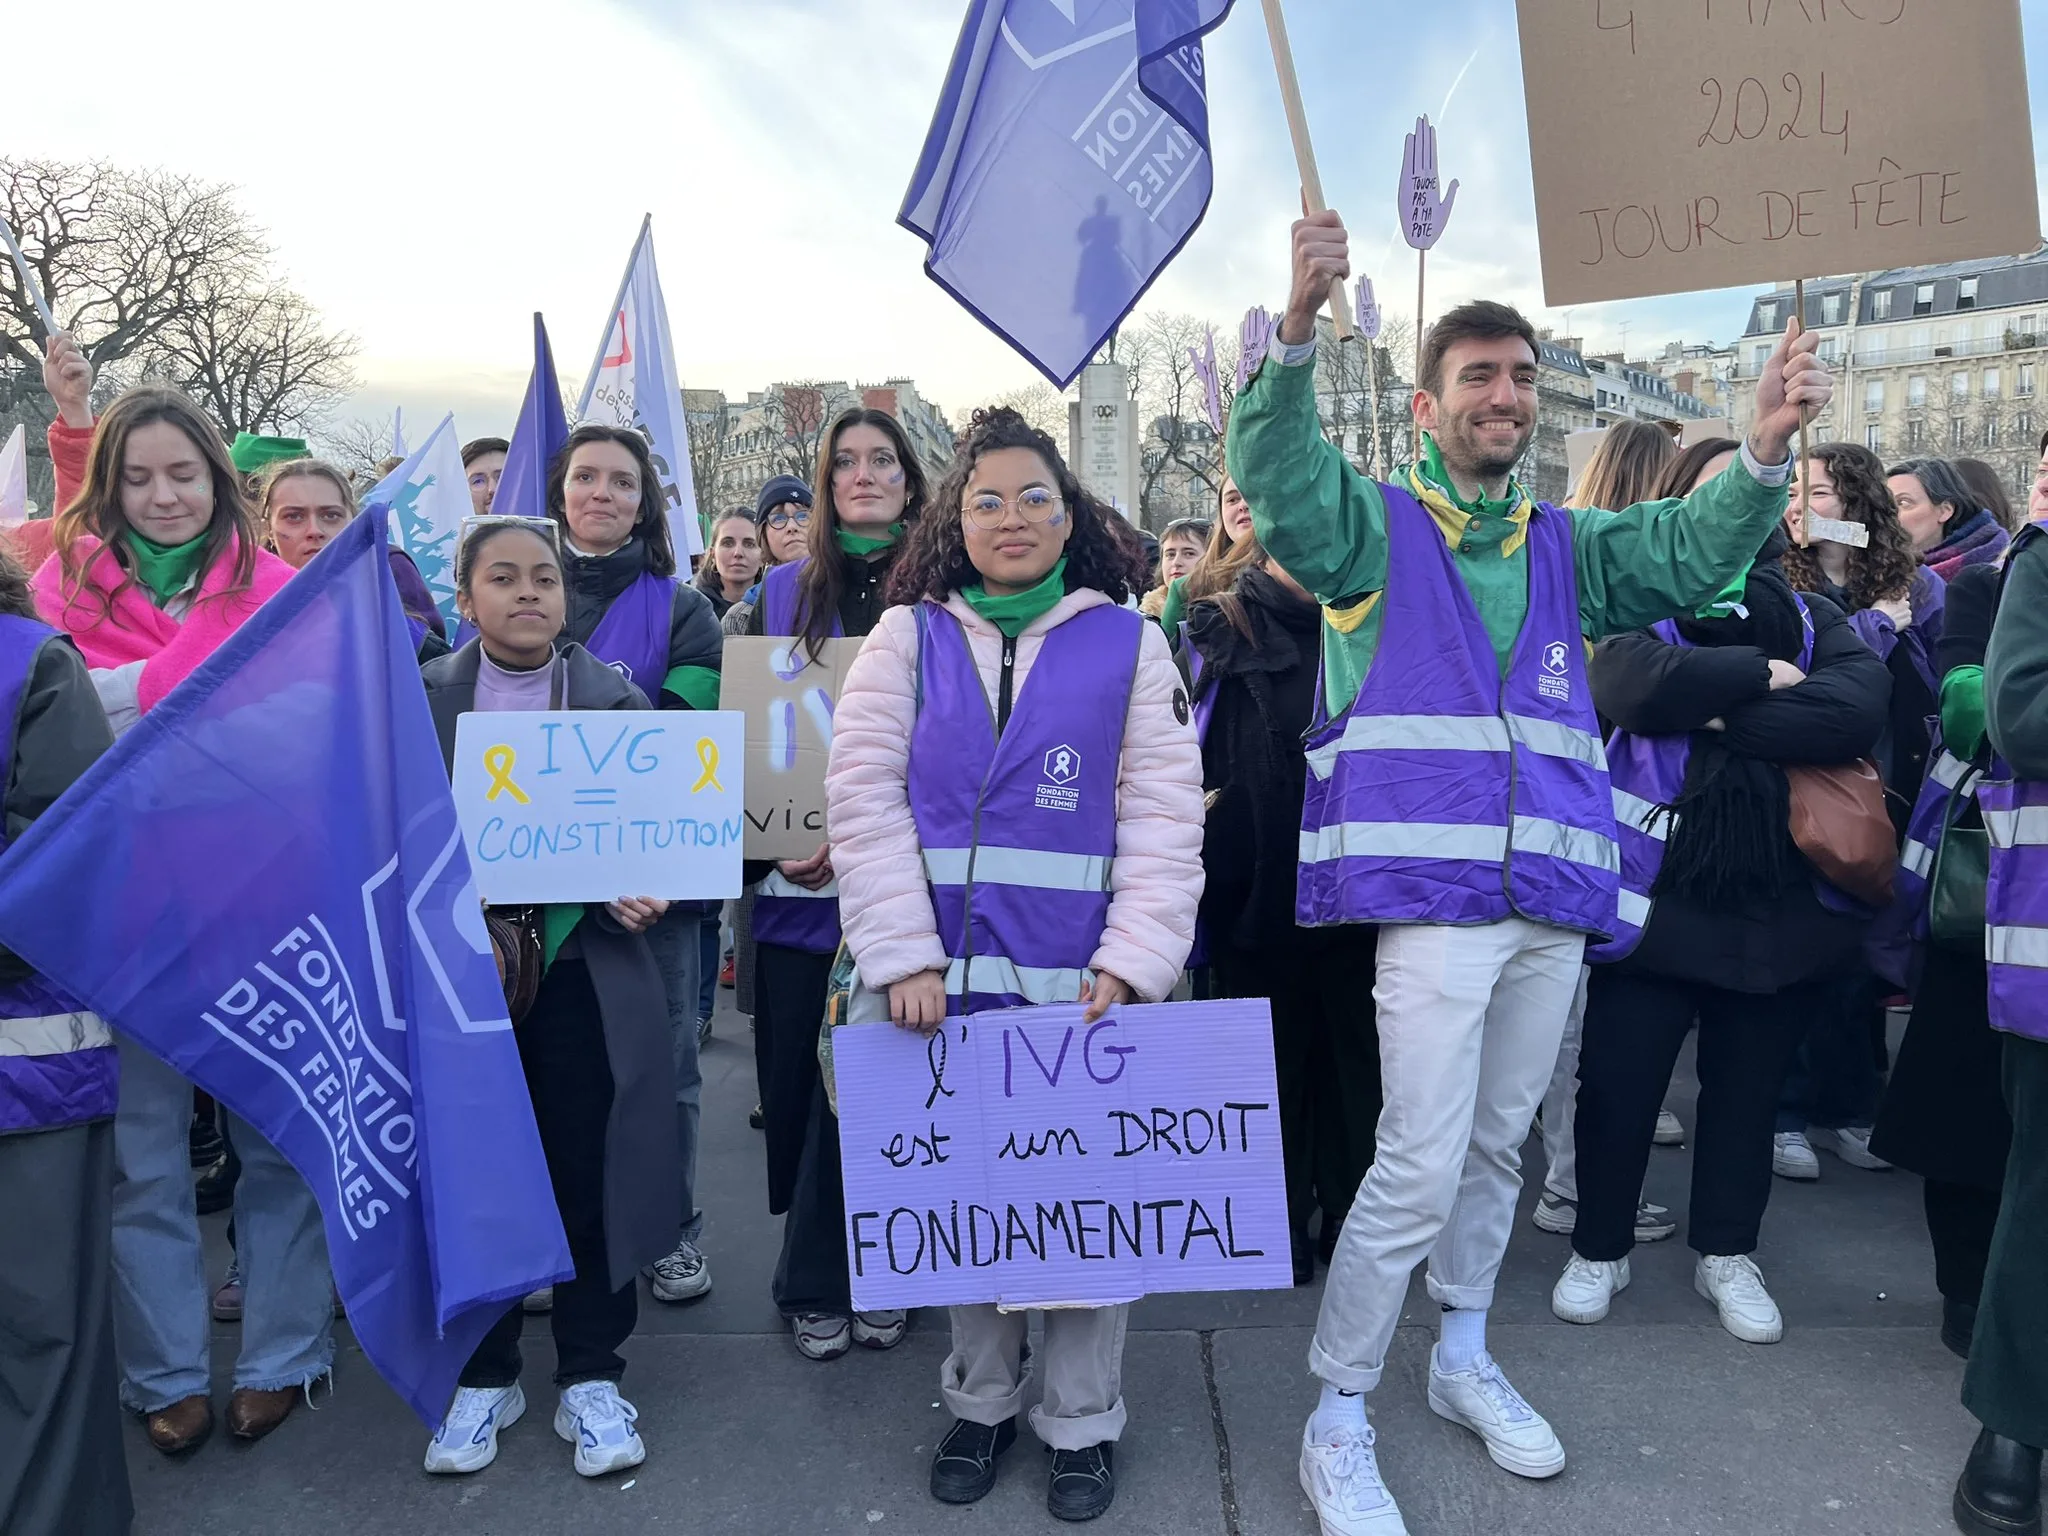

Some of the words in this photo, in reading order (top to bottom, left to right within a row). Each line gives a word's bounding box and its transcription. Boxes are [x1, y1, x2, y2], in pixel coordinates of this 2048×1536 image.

[1698, 72, 1848, 156] 2024
[1412, 176, 1437, 190] TOUCHE
[1412, 191, 1427, 206] PAS
[1579, 196, 1745, 265] JOUR
[1757, 189, 1827, 241] DE
[1849, 157, 1968, 229] FÊTE
[1091, 405, 1118, 418] FOCH
[538, 723, 665, 775] IVG
[1037, 787, 1079, 798] FONDATION
[1051, 799, 1077, 808] FEMMES
[1003, 1019, 1137, 1098] IVG
[214, 977, 307, 1051] DES
[300, 1051, 391, 1230] FEMMES
[880, 1122, 951, 1168] est
[998, 1126, 1088, 1160] un
[1107, 1102, 1269, 1158] DROIT
[852, 1196, 1265, 1277] FONDAMENTAL
